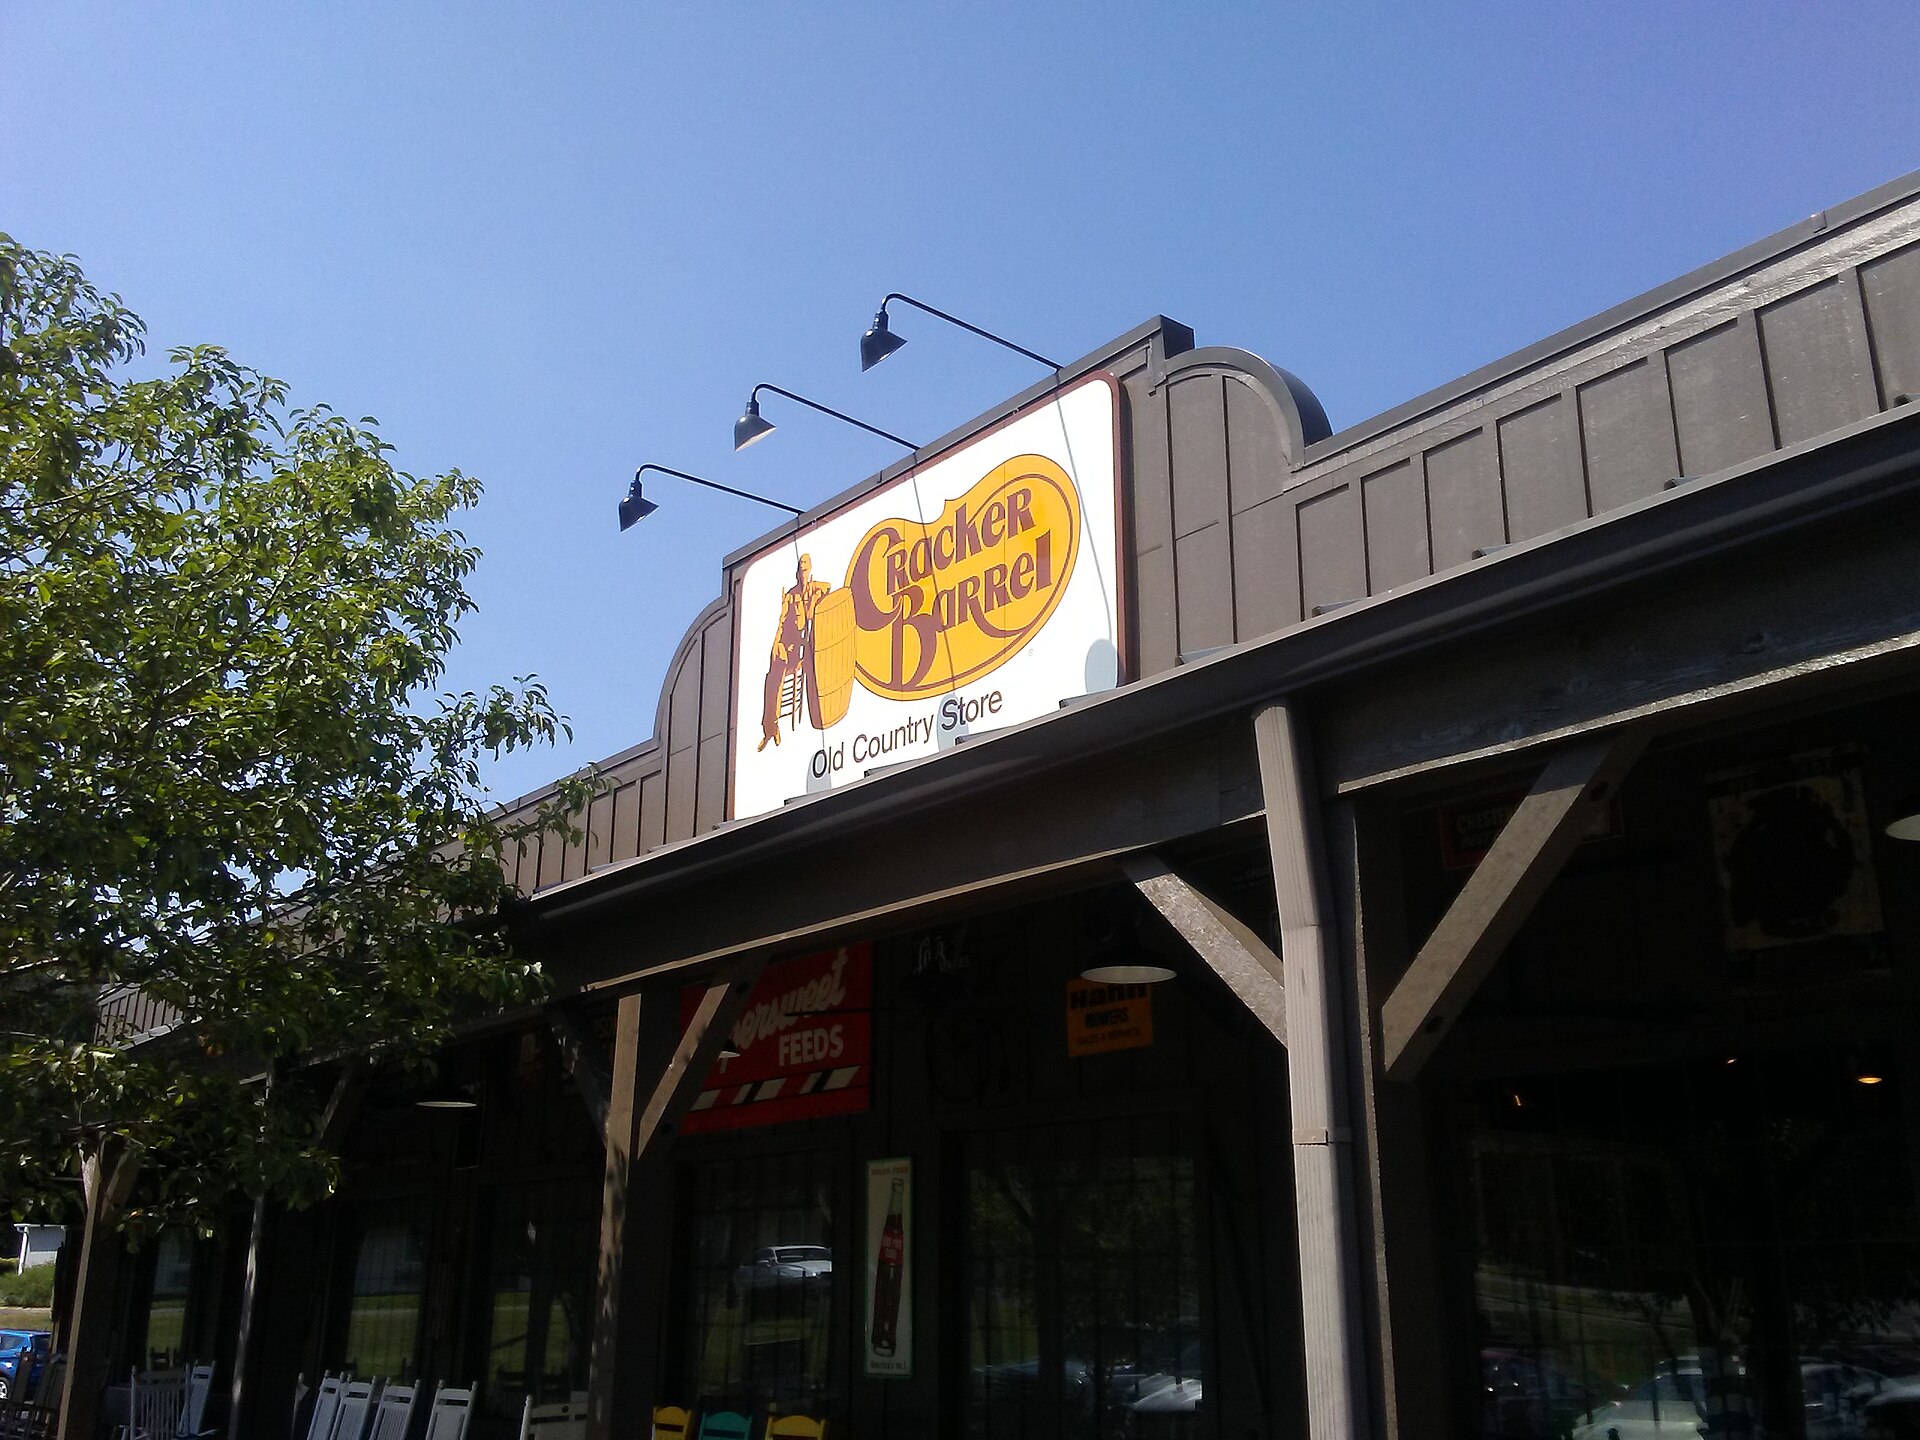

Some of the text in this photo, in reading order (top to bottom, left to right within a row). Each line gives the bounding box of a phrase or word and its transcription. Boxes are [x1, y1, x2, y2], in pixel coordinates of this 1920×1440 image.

[850, 487, 1036, 632] Cracker
[889, 530, 1053, 687] Barrel
[811, 689, 1004, 779] Old Country Store
[778, 1023, 844, 1067] FEEDS
